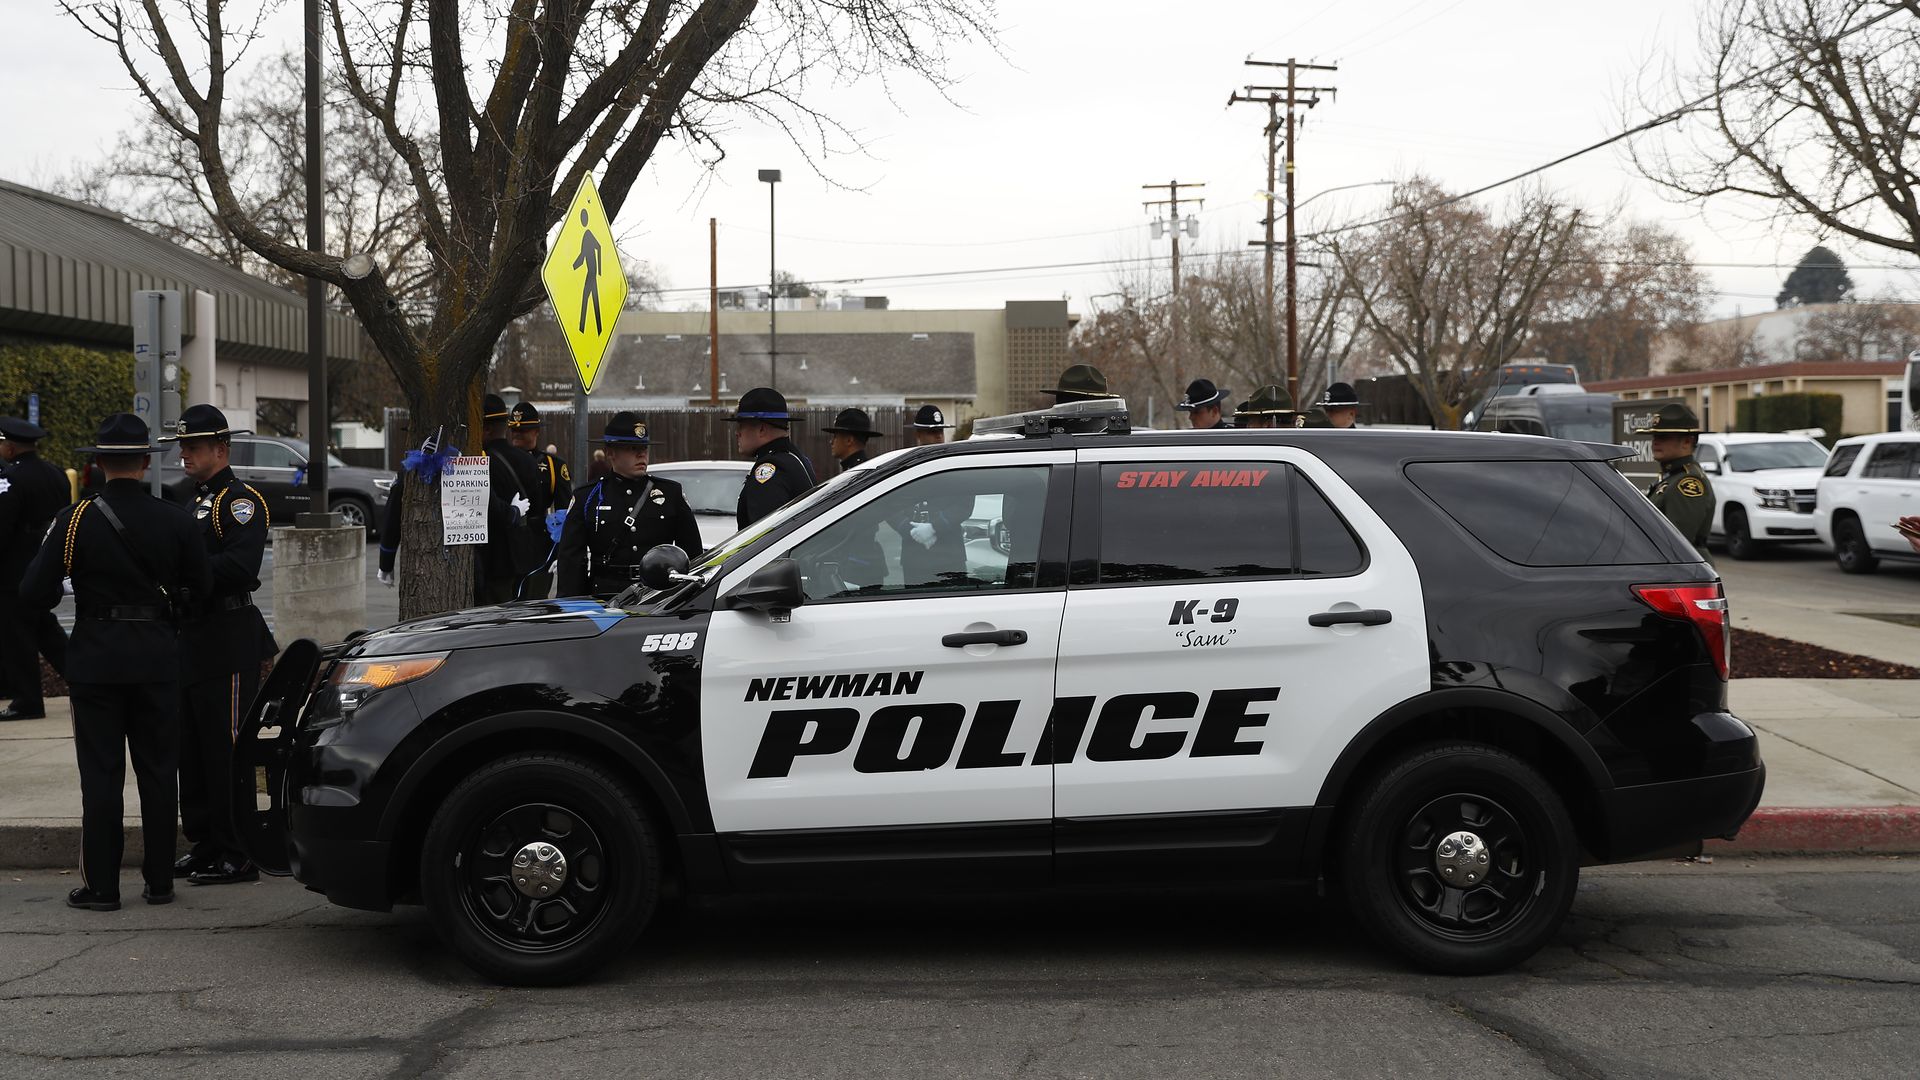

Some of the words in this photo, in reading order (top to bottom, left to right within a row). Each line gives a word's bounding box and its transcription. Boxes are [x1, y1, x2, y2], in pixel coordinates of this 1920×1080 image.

[448, 457, 489, 466] ARNING!
[442, 480, 455, 488] NO
[456, 480, 489, 488] PARKING
[1117, 470, 1189, 489] STAY
[1190, 469, 1269, 488] AWAY
[447, 532, 486, 543] 572-9500
[1168, 598, 1239, 625] K-9
[641, 632, 698, 652] 598
[744, 670, 924, 702] NEWMAN
[746, 687, 1281, 779] POLICE
